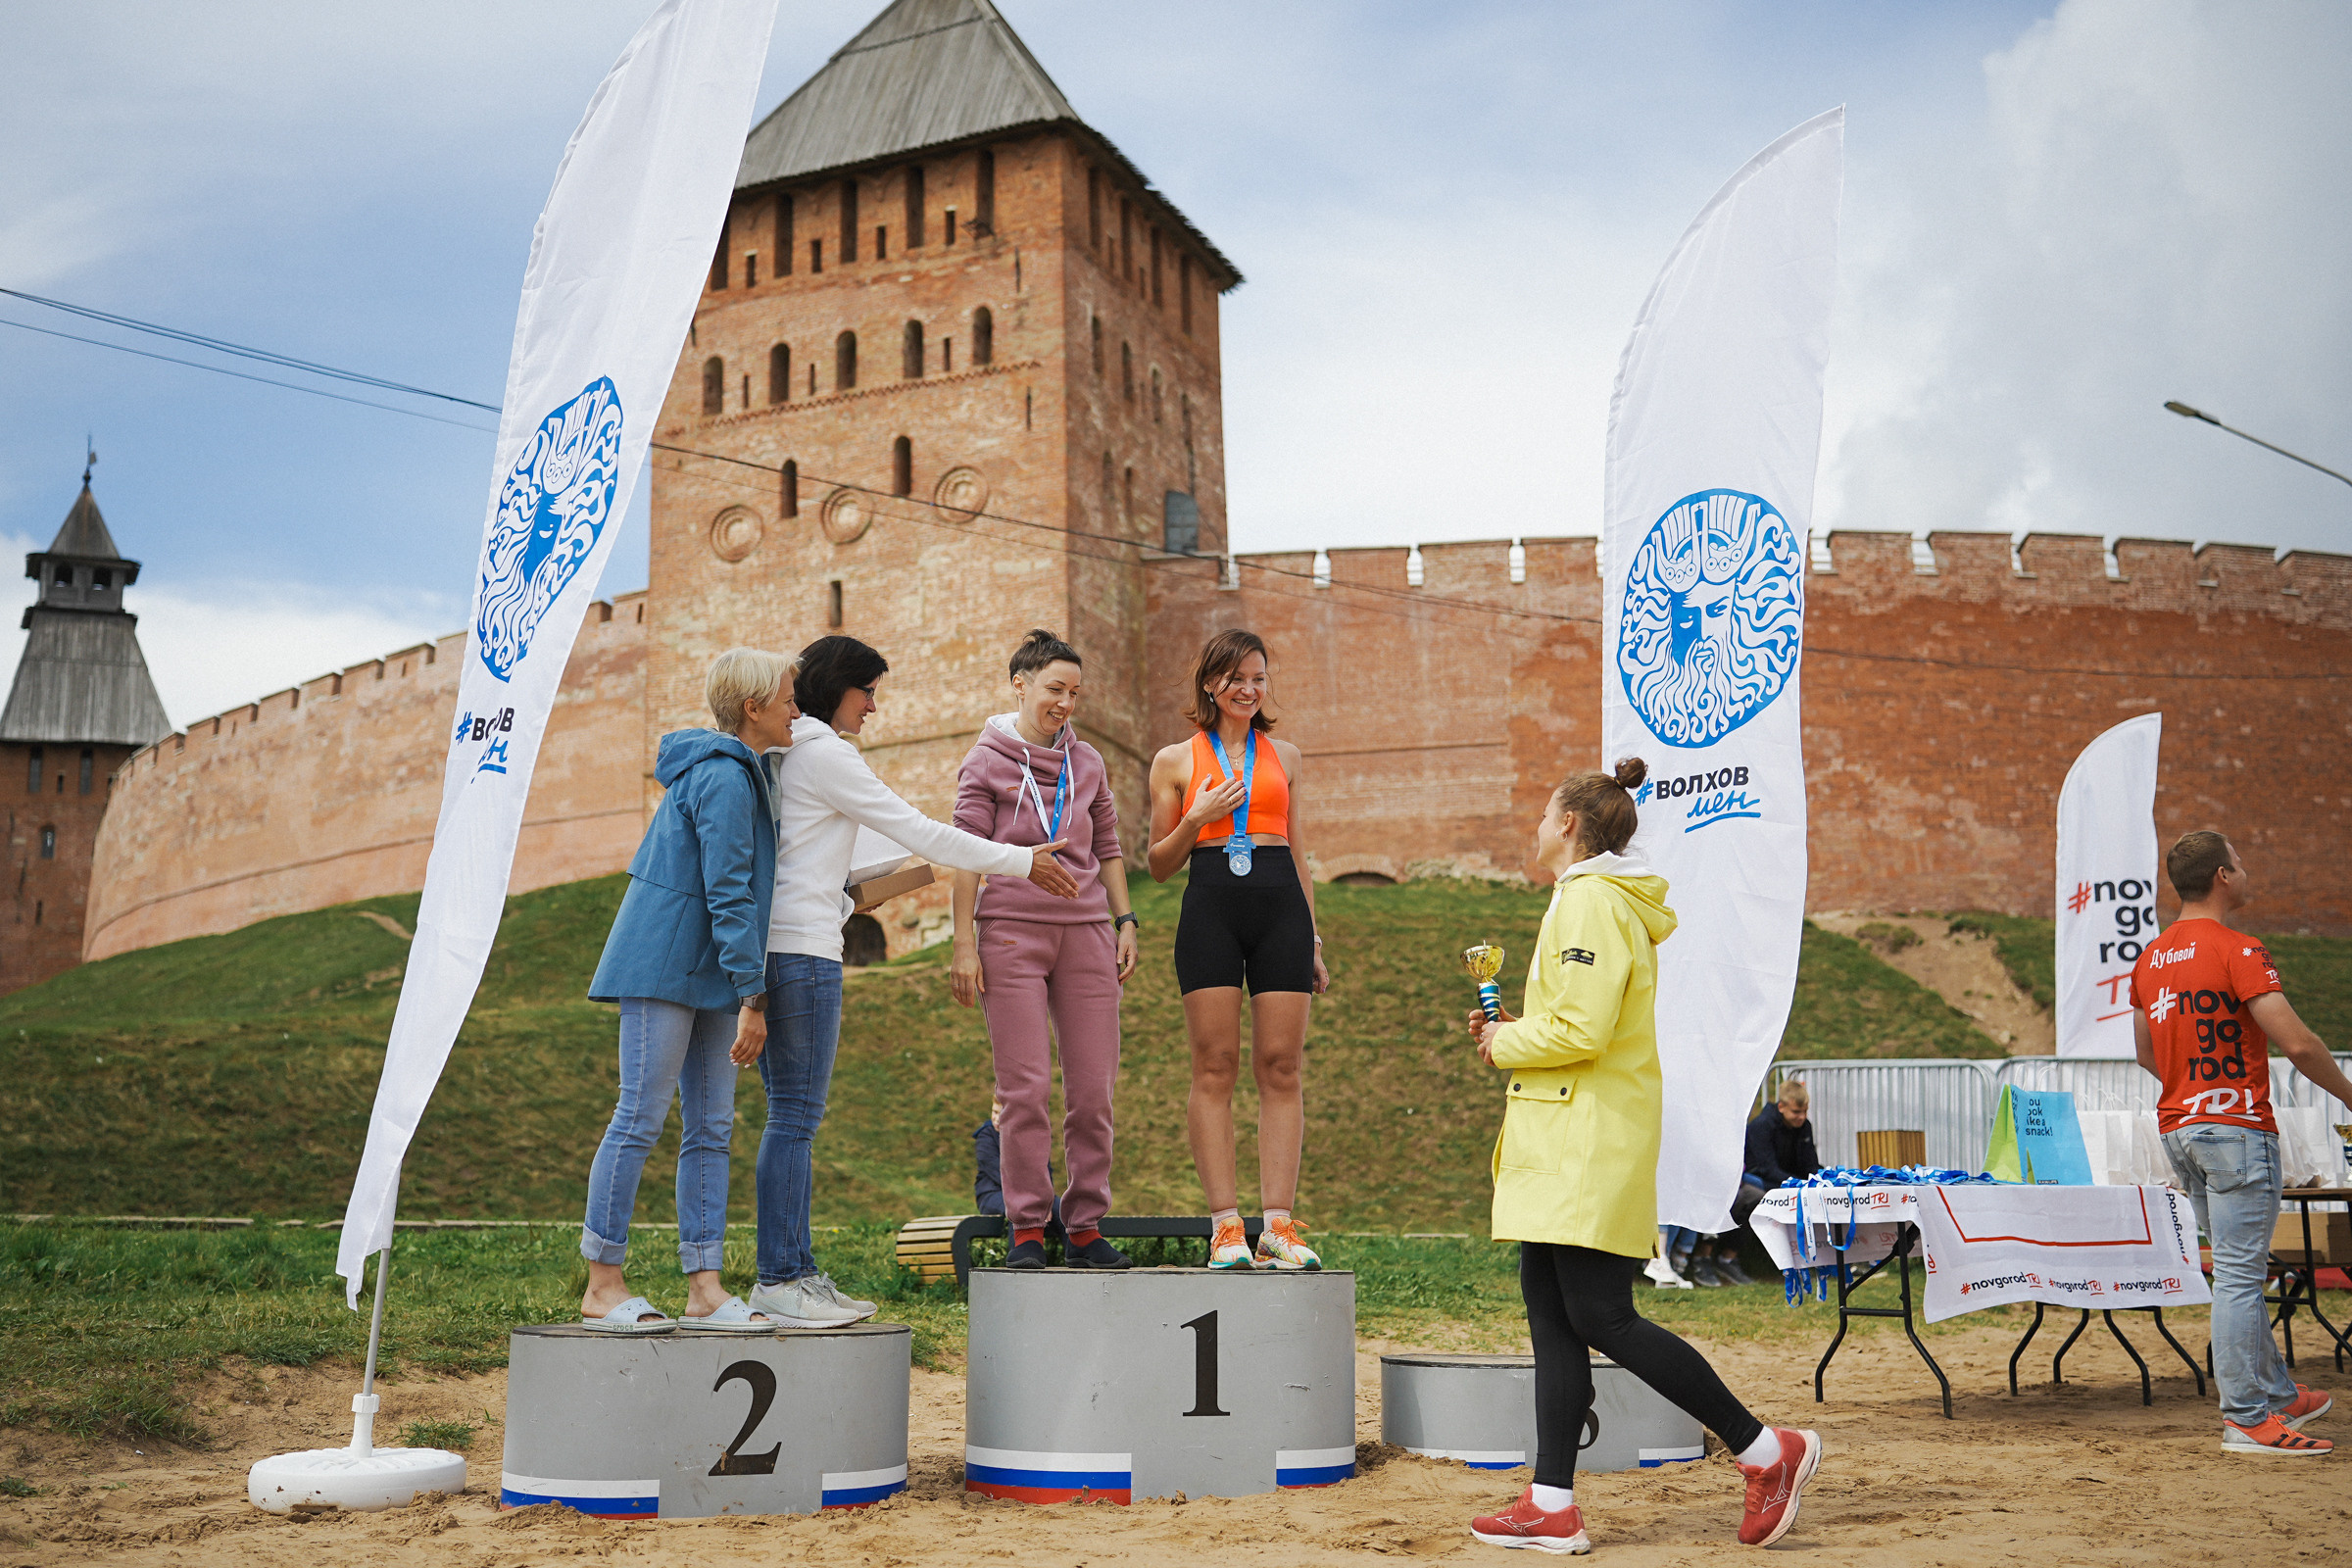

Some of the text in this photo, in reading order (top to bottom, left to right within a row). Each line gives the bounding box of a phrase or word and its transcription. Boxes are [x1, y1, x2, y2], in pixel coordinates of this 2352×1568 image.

[1634, 766, 1749, 807] #ВОЛХОВ
[1687, 790, 1761, 818] мен
[2099, 938, 2154, 963] ro
[2149, 942, 2196, 969] Дубовой
[2149, 986, 2243, 1024] #nov
[2195, 1018, 2243, 1054] go
[2188, 1042, 2247, 1082] rod
[2025, 1127, 2054, 1137] snack!
[1180, 1309, 1231, 1417] 1
[708, 1359, 782, 1477] 2
